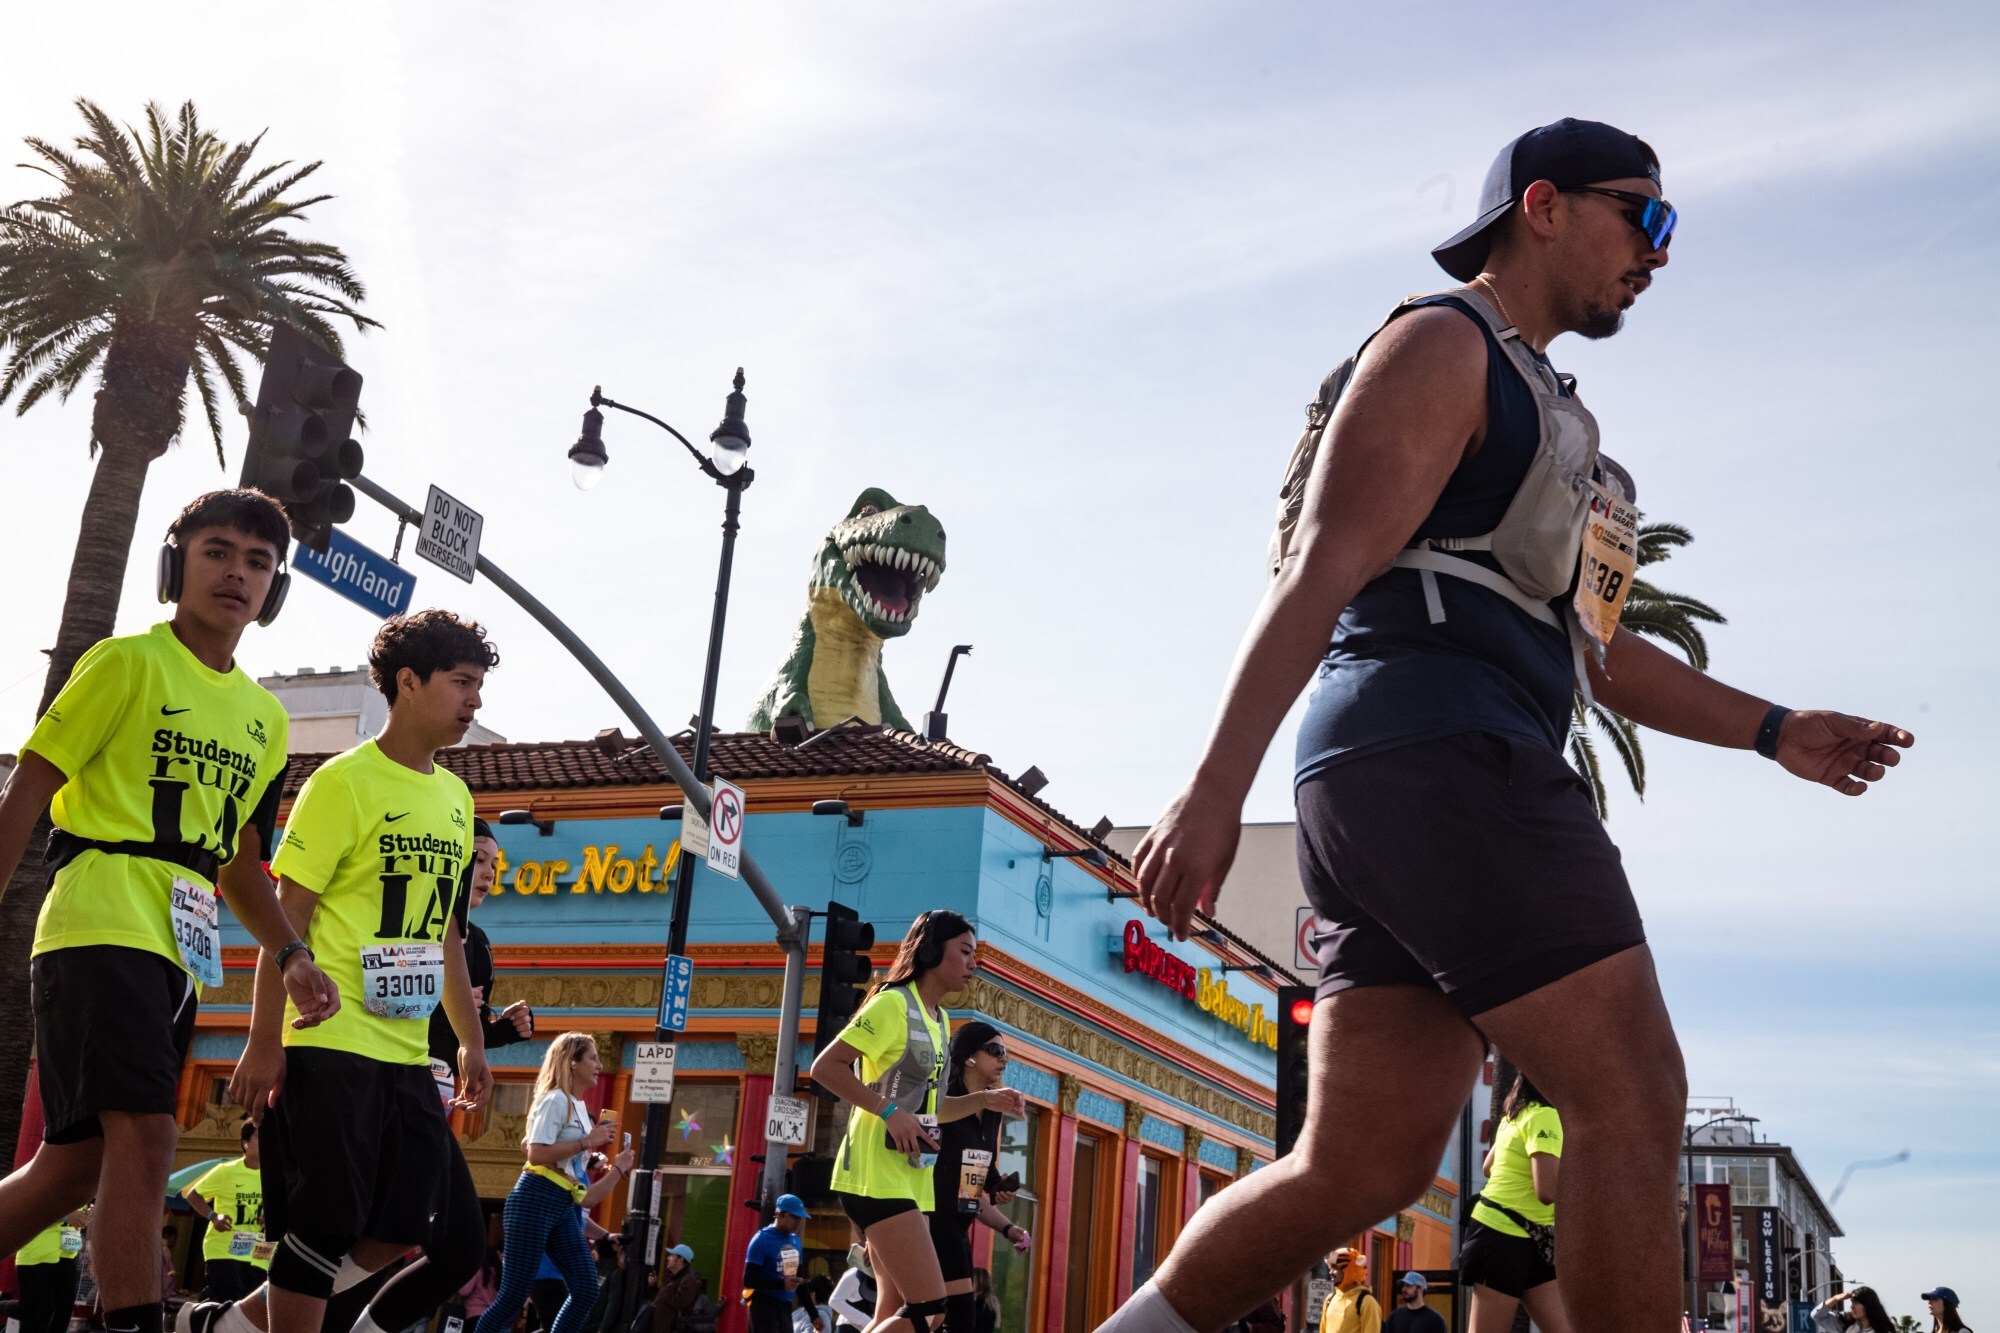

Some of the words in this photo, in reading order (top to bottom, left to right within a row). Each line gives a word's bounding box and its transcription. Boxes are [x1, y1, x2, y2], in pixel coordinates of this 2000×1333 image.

[433, 495, 449, 519] DO
[453, 507, 476, 535] NOT
[419, 537, 472, 577] INTERSECTION
[431, 520, 469, 557] BLOCK
[152, 728, 256, 779] Students
[149, 755, 250, 802] run
[379, 833, 463, 860] Students
[710, 846, 721, 862] ON
[722, 851, 737, 869] RED
[379, 854, 460, 880] run
[489, 848, 510, 896] t
[514, 859, 572, 896] or
[570, 838, 681, 895] Not!
[374, 875, 455, 942] LA
[376, 974, 435, 998] 33010
[666, 960, 676, 1000] SIGNAL
[671, 961, 690, 1027] SYNC
[1195, 967, 1251, 1033] Believe
[1248, 1003, 1265, 1043] It
[638, 1047, 674, 1059] LAPD
[768, 1119, 784, 1138] OK
[774, 1105, 803, 1116] CROSSING
[236, 1191, 263, 1200] Stude
[1761, 1211, 1773, 1237] NOW
[1311, 1282, 1331, 1291] CROSS
[1764, 1240, 1774, 1299] LEASING
